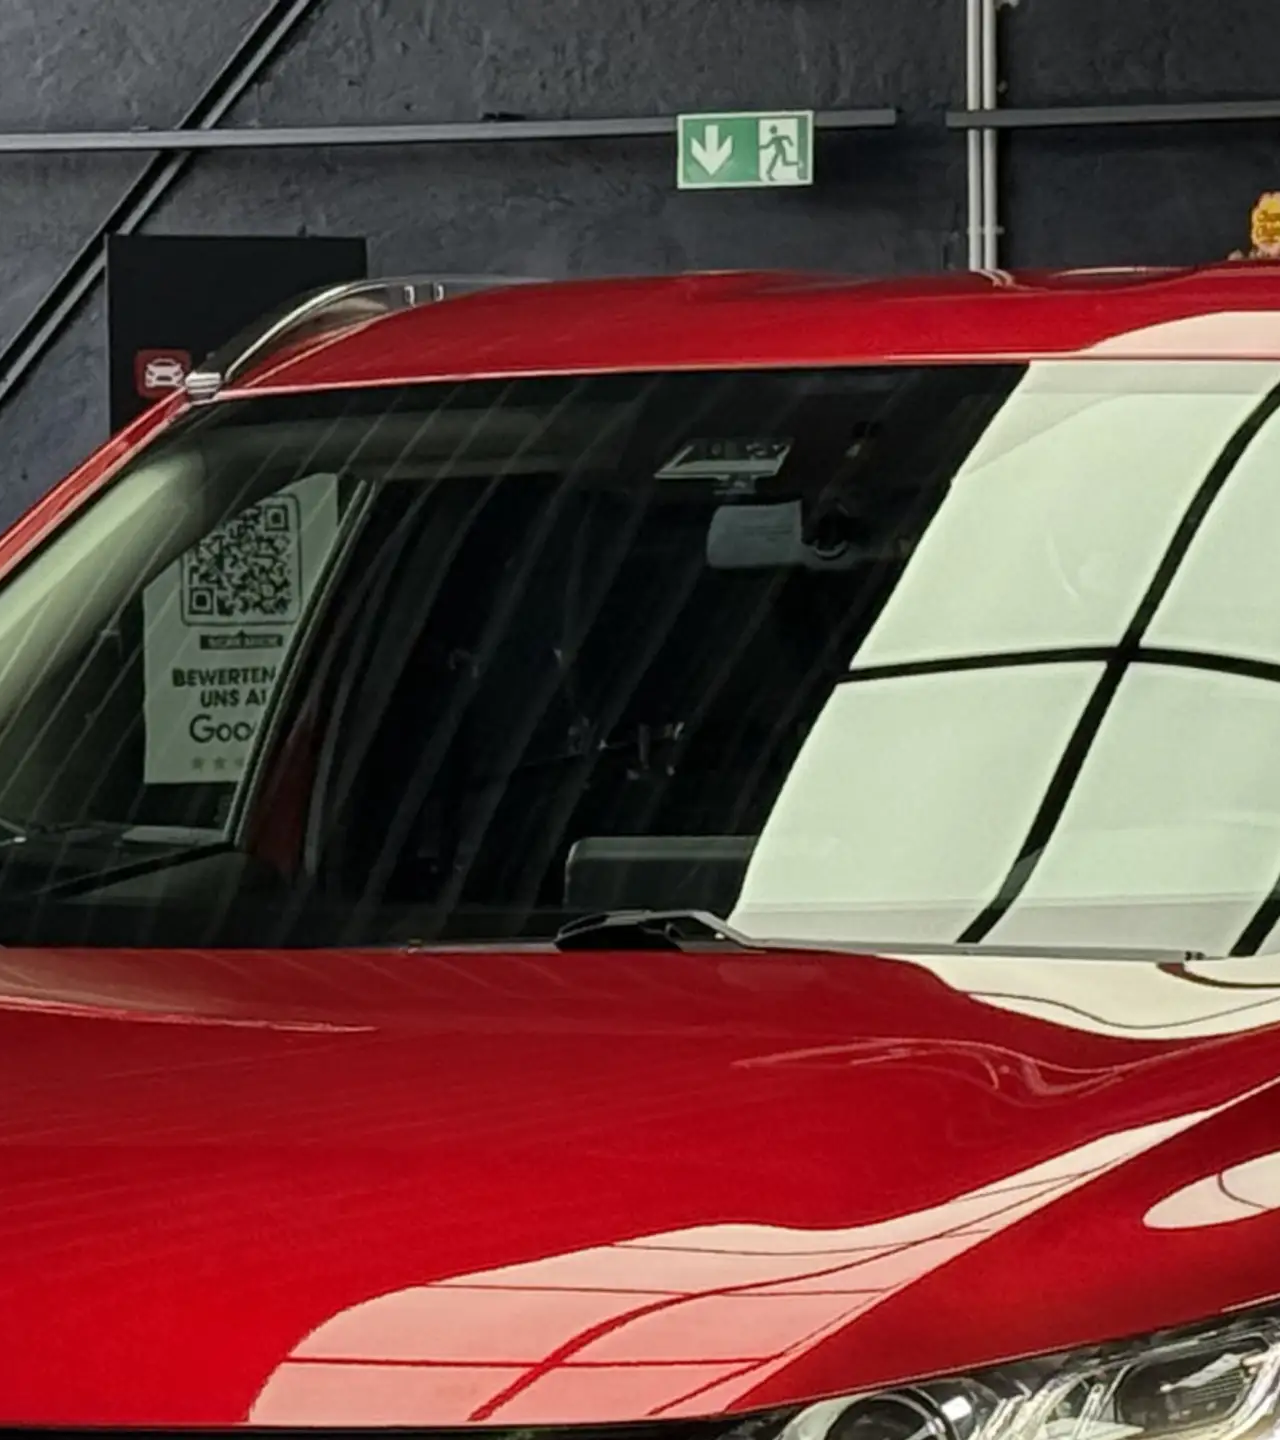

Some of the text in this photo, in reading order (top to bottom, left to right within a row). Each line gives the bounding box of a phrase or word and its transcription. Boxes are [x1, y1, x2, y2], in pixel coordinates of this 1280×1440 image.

[172, 666, 276, 687] BEWERTEN
[200, 689, 240, 707] UNS
[189, 713, 258, 743] Goo
